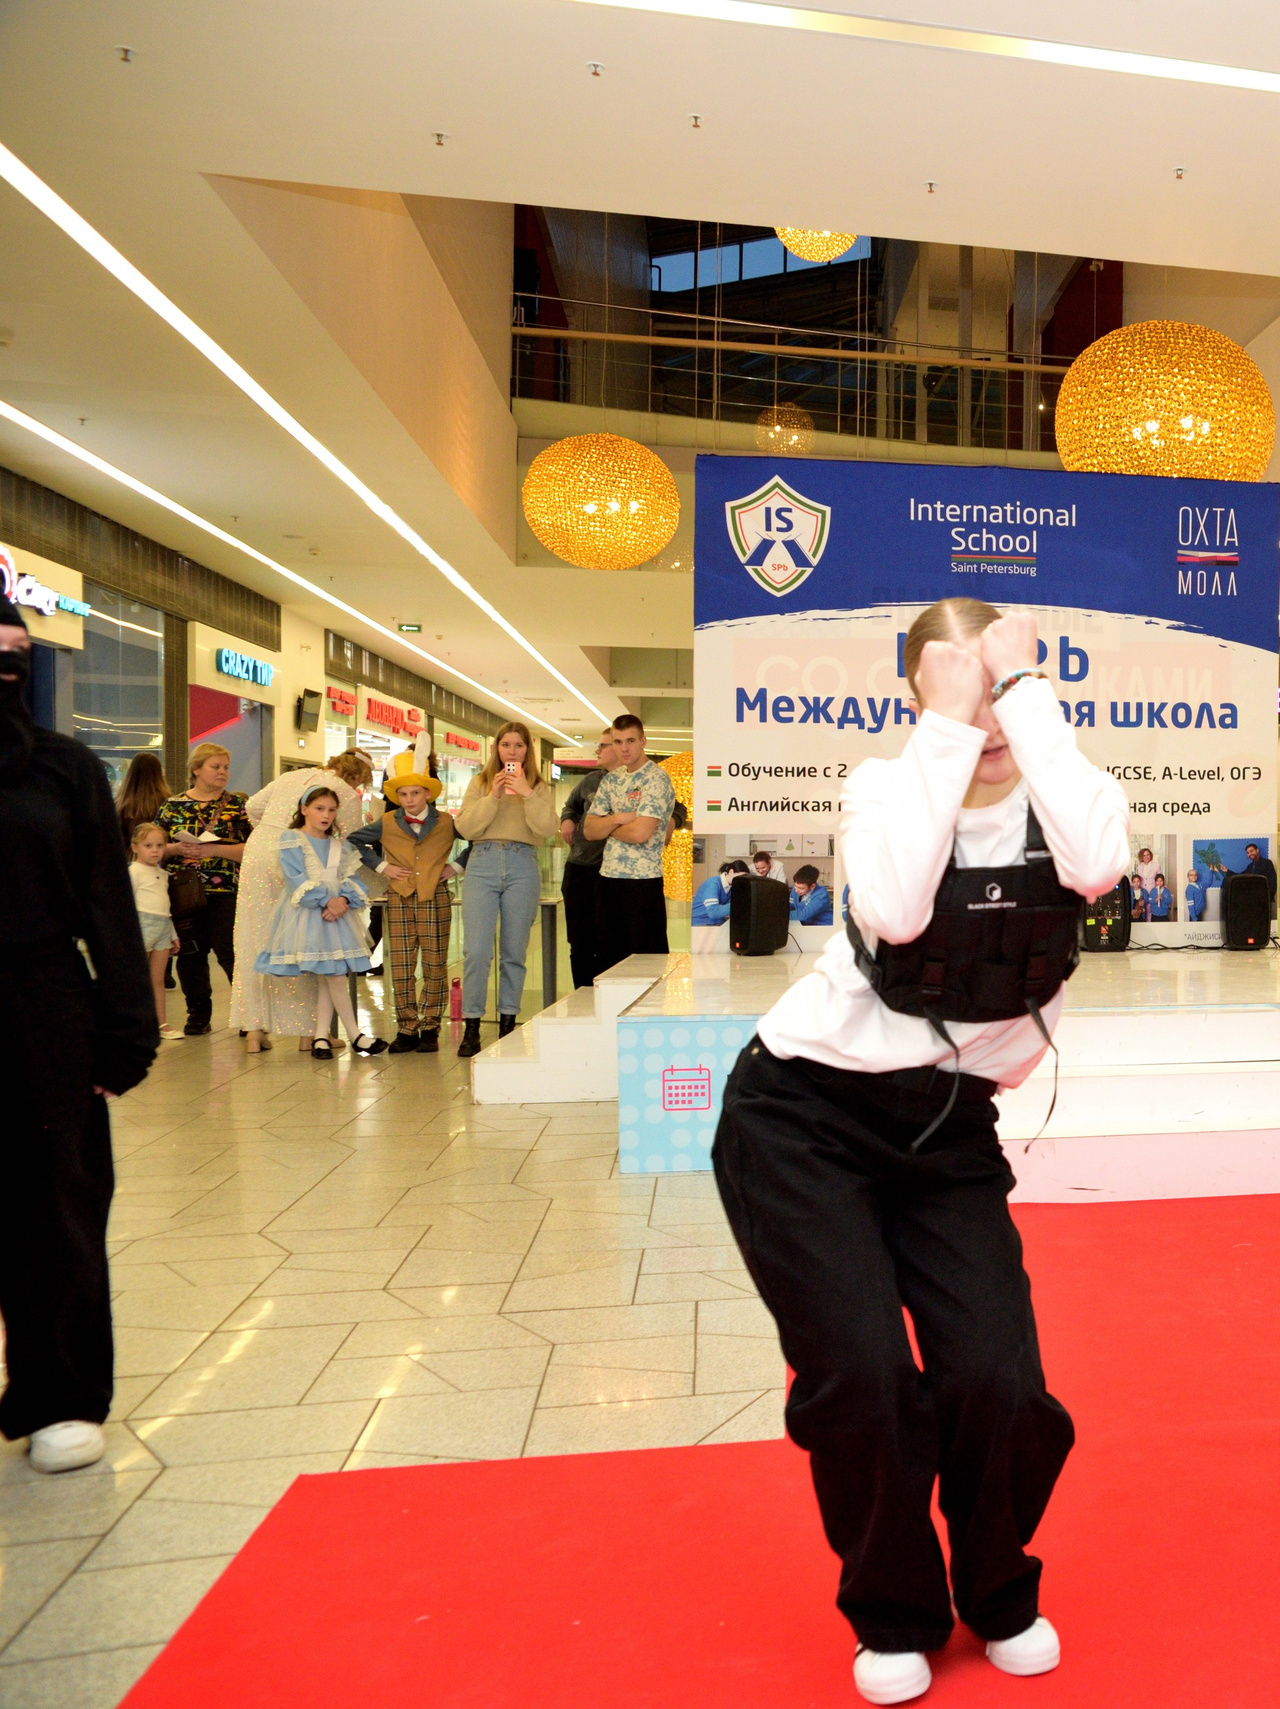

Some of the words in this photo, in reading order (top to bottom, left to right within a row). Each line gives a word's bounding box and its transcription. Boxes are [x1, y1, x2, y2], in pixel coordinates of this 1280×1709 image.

[765, 506, 795, 533] IS
[909, 498, 1077, 527] International
[1178, 506, 1239, 547] ОХТА
[950, 527, 1038, 553] School
[771, 563, 789, 572] SPb
[951, 562, 978, 574] Saint
[980, 562, 1037, 577] Petersburg
[1178, 570, 1238, 596] МОЛЛ
[221, 648, 255, 682] CRAZY
[255, 660, 274, 687] ТИР
[1110, 701, 1238, 730] школа
[728, 762, 818, 780] Обучение
[823, 766, 832, 778] с
[1161, 766, 1225, 782] A-Level,
[1230, 766, 1262, 780] ОГЭ
[727, 796, 832, 813] Английская
[1162, 802, 1211, 816] среда
